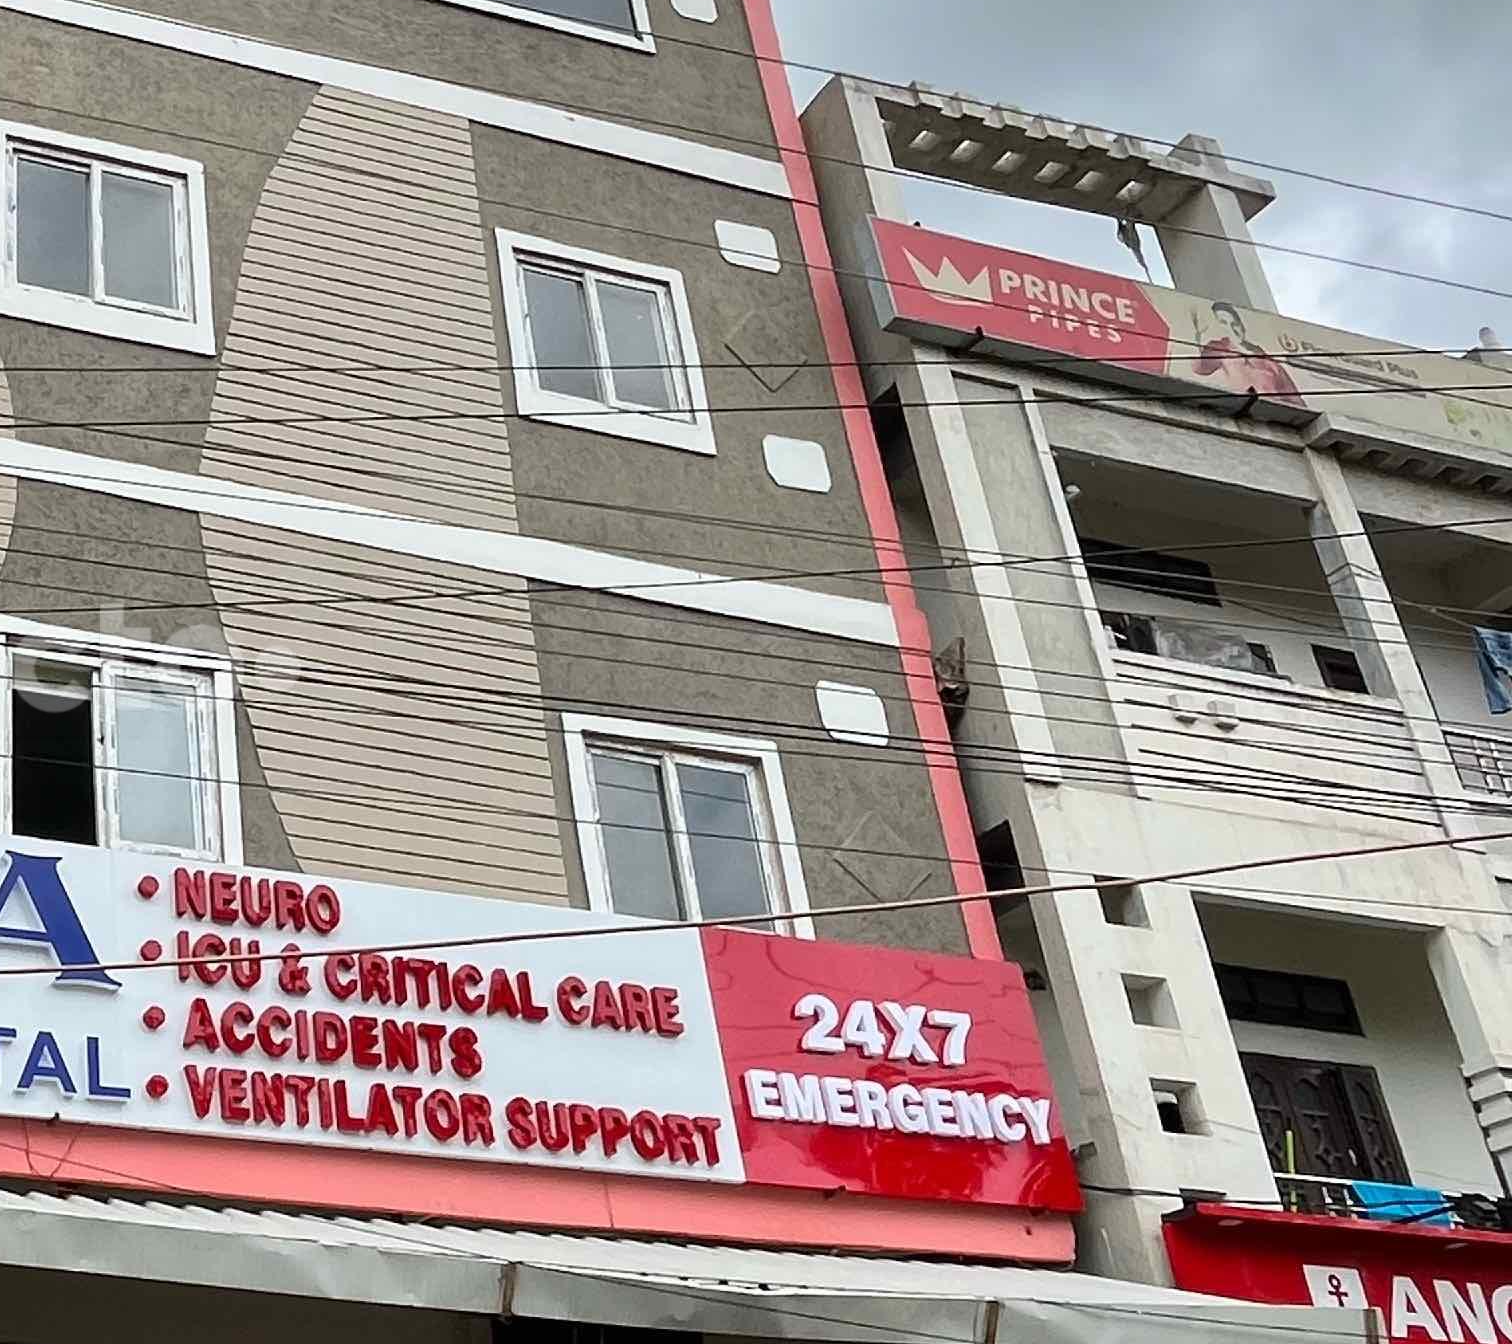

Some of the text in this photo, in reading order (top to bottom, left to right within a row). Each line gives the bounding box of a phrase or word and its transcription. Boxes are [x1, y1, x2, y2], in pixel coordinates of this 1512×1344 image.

[998, 268, 1136, 324] PRINCE
[1027, 304, 1122, 344] PIPES
[173, 867, 341, 935] NEURO
[176, 931, 685, 1037] ICU & CRITICAL CARE
[182, 997, 483, 1079] ACCIDENTS
[795, 992, 974, 1066] 24X7
[184, 1064, 724, 1169] VENTILATOR SUPPORT
[744, 1067, 1052, 1146] EMERGENCY
